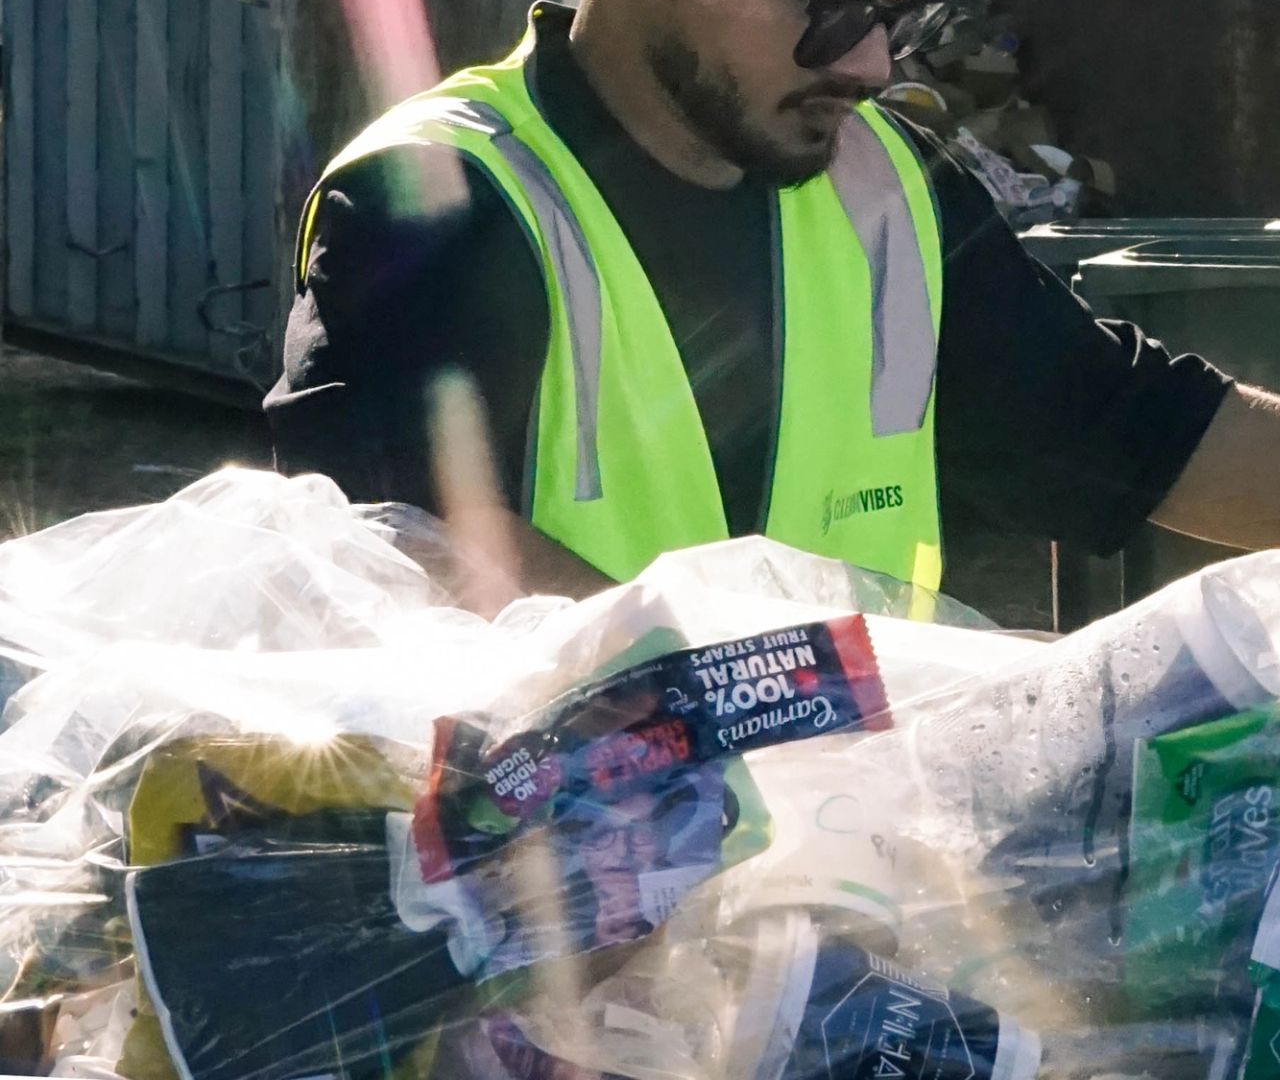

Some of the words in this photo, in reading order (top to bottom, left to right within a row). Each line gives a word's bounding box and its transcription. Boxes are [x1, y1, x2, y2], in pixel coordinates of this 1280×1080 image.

[690, 639, 756, 668] STRAPS
[761, 628, 808, 649] FRUIT
[694, 644, 817, 690] NATURAL
[704, 674, 796, 716] 100%
[717, 696, 837, 750] Carman's
[484, 747, 530, 784] SUGAR
[494, 758, 537, 797] ADDED
[514, 778, 538, 801] NO
